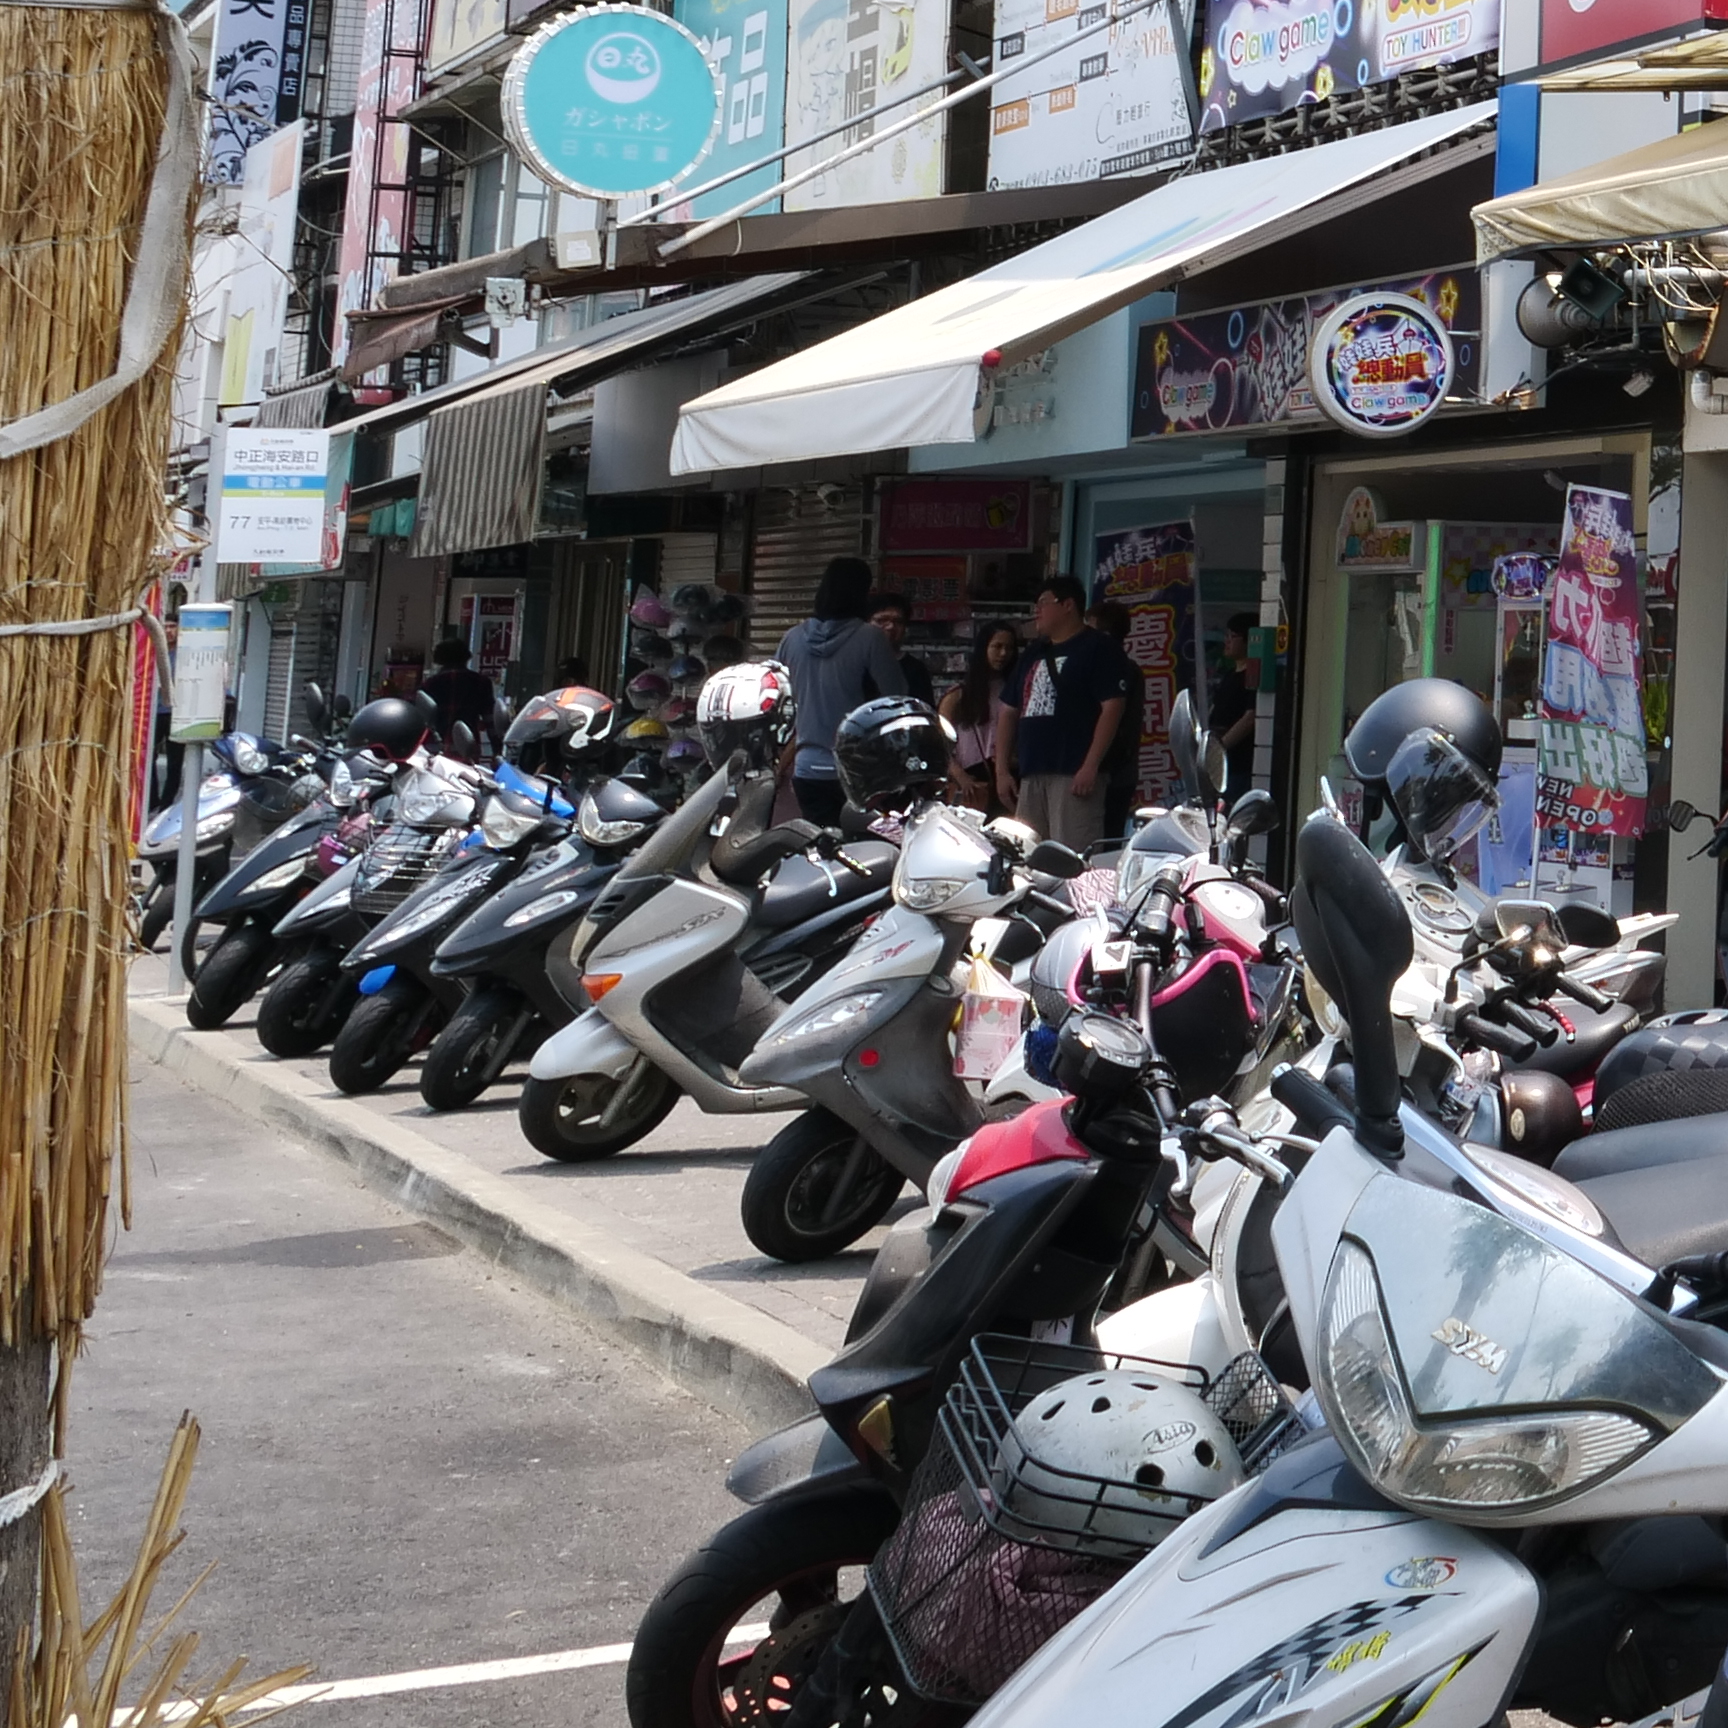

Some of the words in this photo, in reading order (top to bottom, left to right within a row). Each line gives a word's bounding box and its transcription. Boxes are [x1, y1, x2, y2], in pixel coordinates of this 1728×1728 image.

[1230, 20, 1276, 69] Claw
[1279, 10, 1331, 69] game
[1386, 33, 1407, 58] TOY
[1351, 395, 1384, 410] Claw
[1387, 393, 1428, 410] game
[234, 448, 319, 463] 中正海安路口
[230, 515, 251, 529] 77
[1430, 1317, 1510, 1375] SYM
